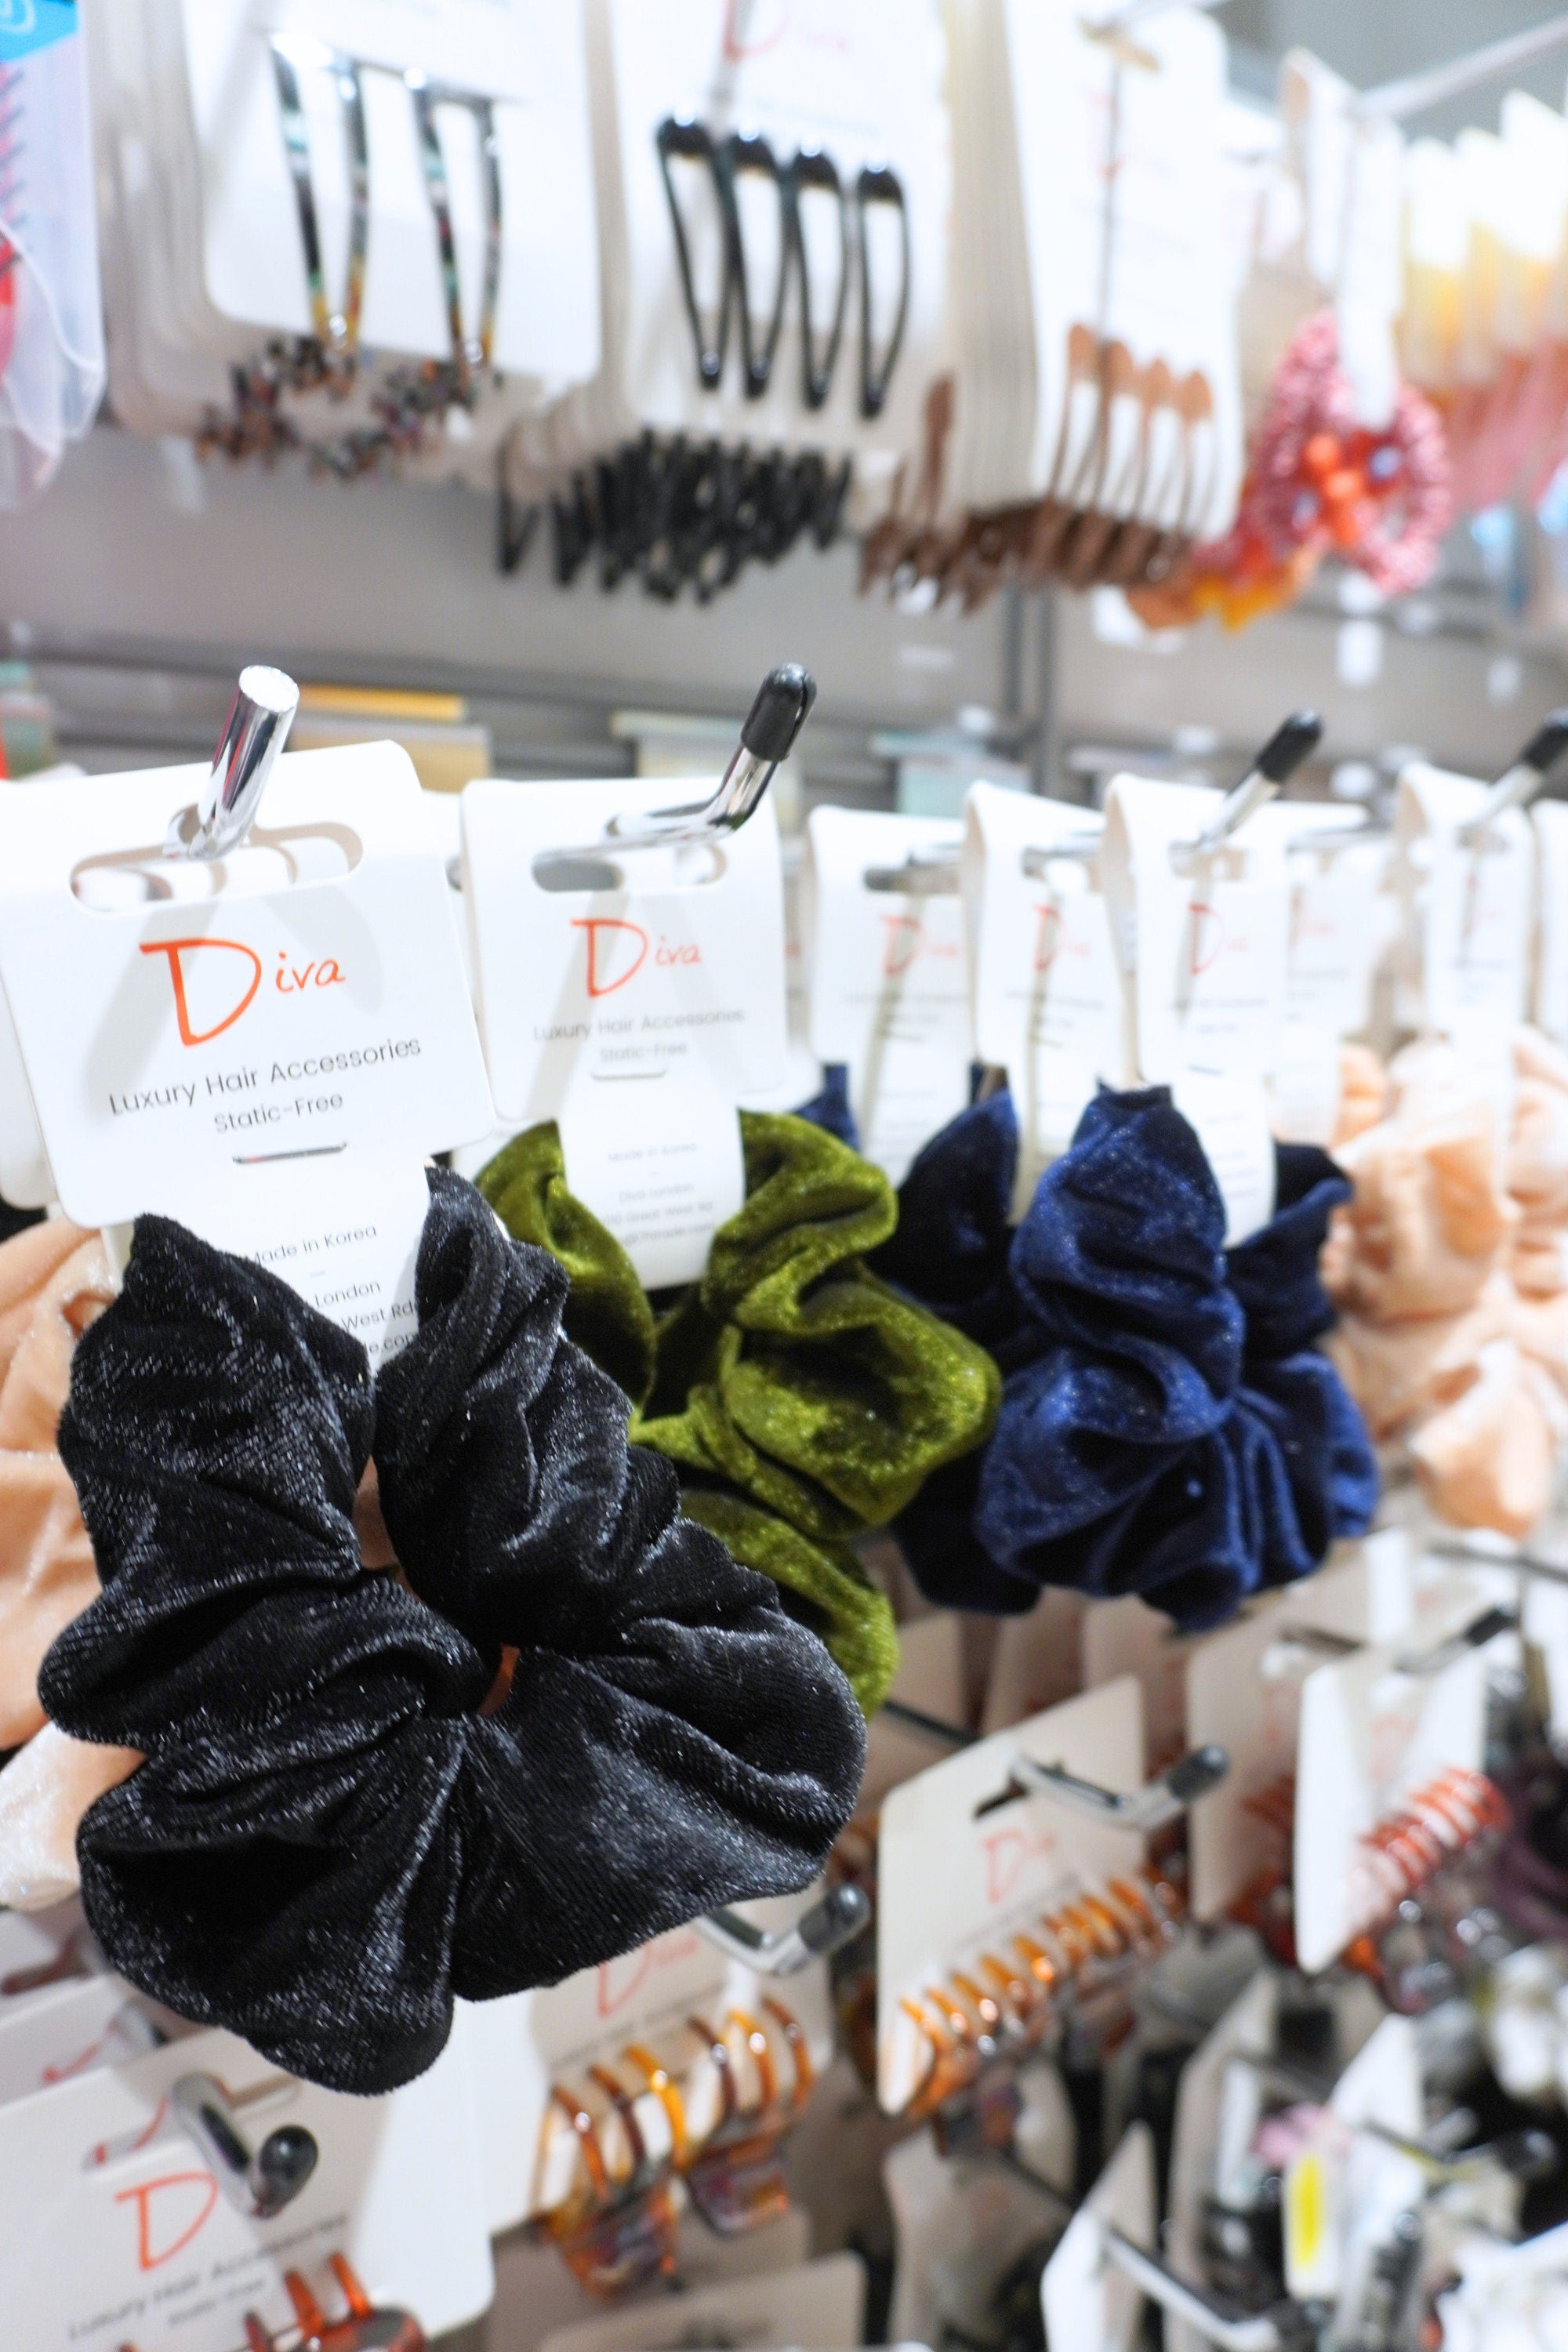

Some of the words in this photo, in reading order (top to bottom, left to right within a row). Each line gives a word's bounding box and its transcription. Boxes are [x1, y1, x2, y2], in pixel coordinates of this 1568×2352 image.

[570, 917, 702, 997] Diva
[139, 938, 346, 1047] Diva
[534, 1023, 591, 1041] Luxury
[598, 1015, 633, 1034] Hair
[641, 1007, 746, 1033] Accessories
[600, 1042, 687, 1062] Static-Free
[109, 1082, 196, 1116] Luxury
[205, 1066, 259, 1096] Hair
[270, 1036, 422, 1084] Accessories
[214, 1093, 343, 1134] Static-Free
[302, 1238, 320, 1254] in
[324, 1225, 377, 1248] Korea
[314, 1280, 382, 1308] London
[341, 1308, 385, 1333] West
[391, 1299, 414, 1319] Rd
